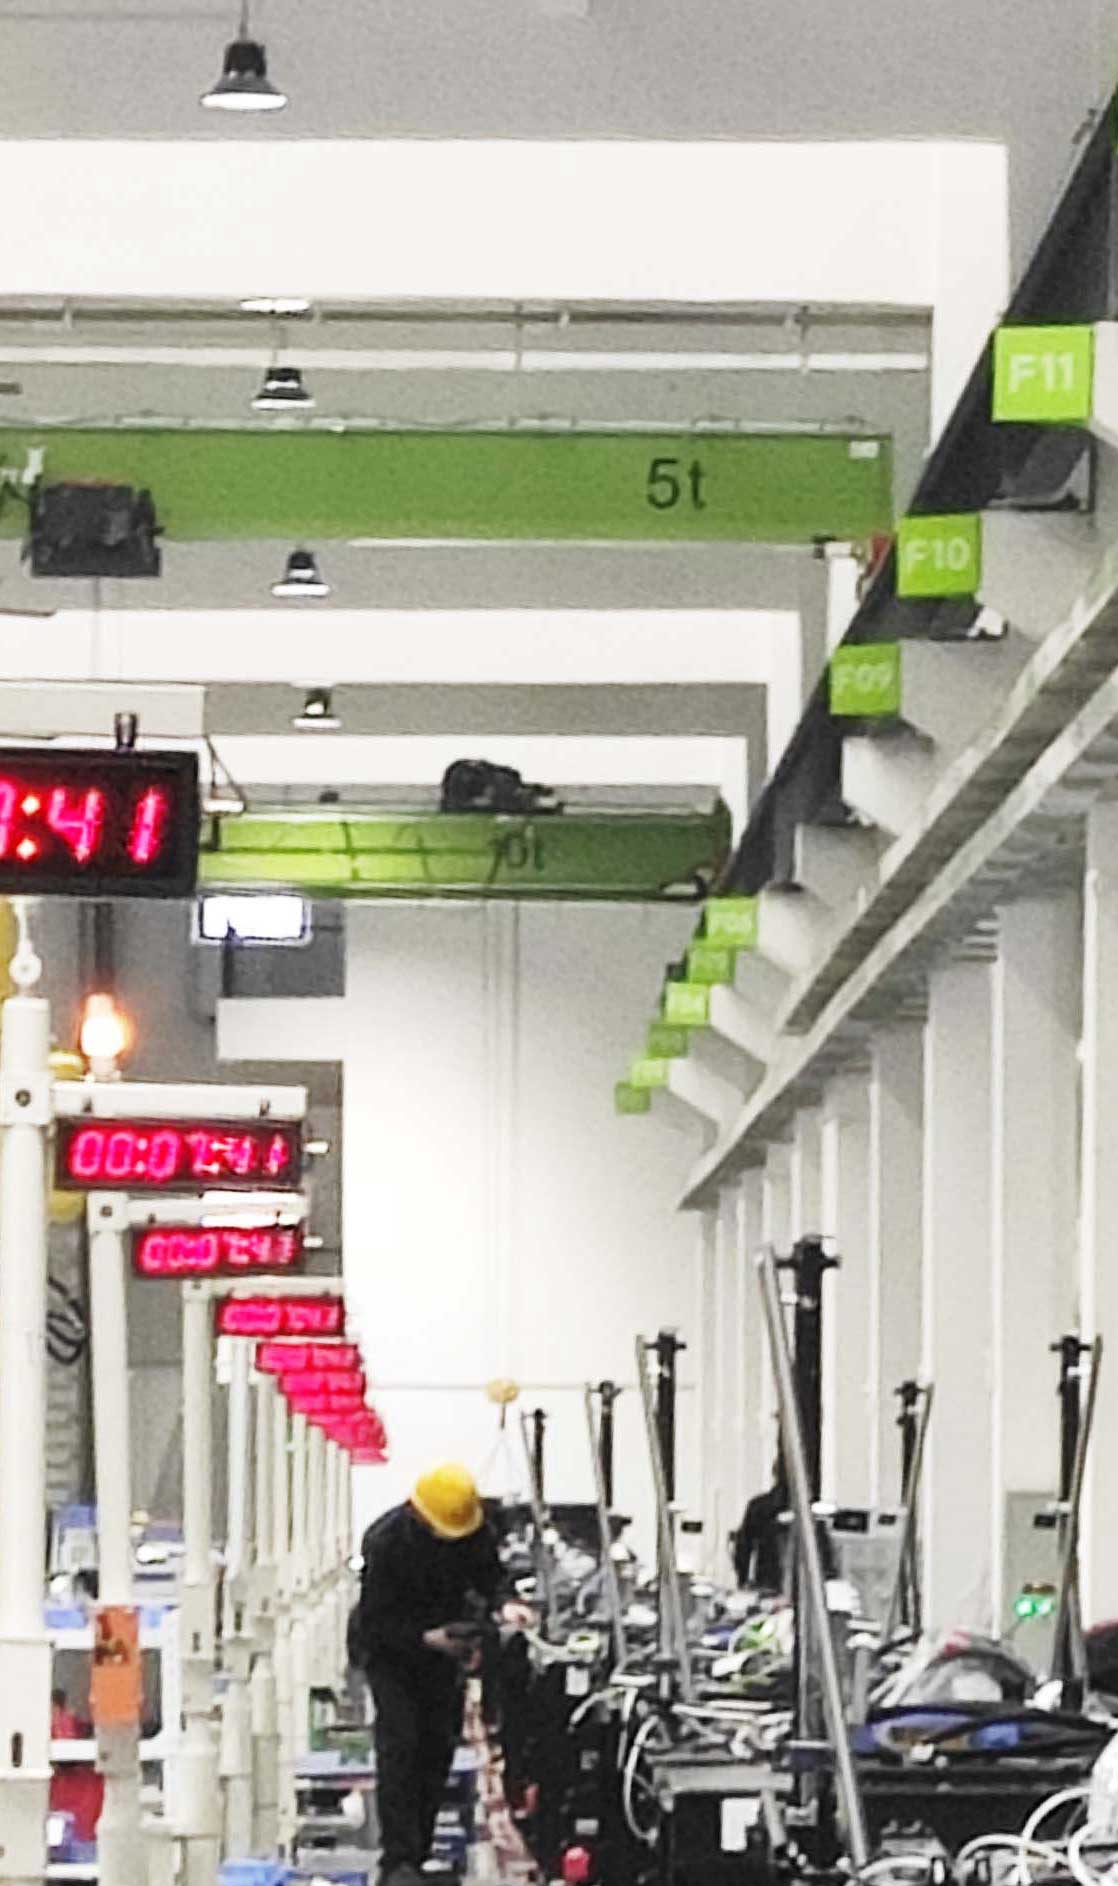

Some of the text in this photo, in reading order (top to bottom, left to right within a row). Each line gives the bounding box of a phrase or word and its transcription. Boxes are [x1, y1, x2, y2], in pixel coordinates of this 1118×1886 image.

[1008, 352, 1074, 393] F11
[646, 457, 708, 510] 5t
[905, 536, 970, 574] F10
